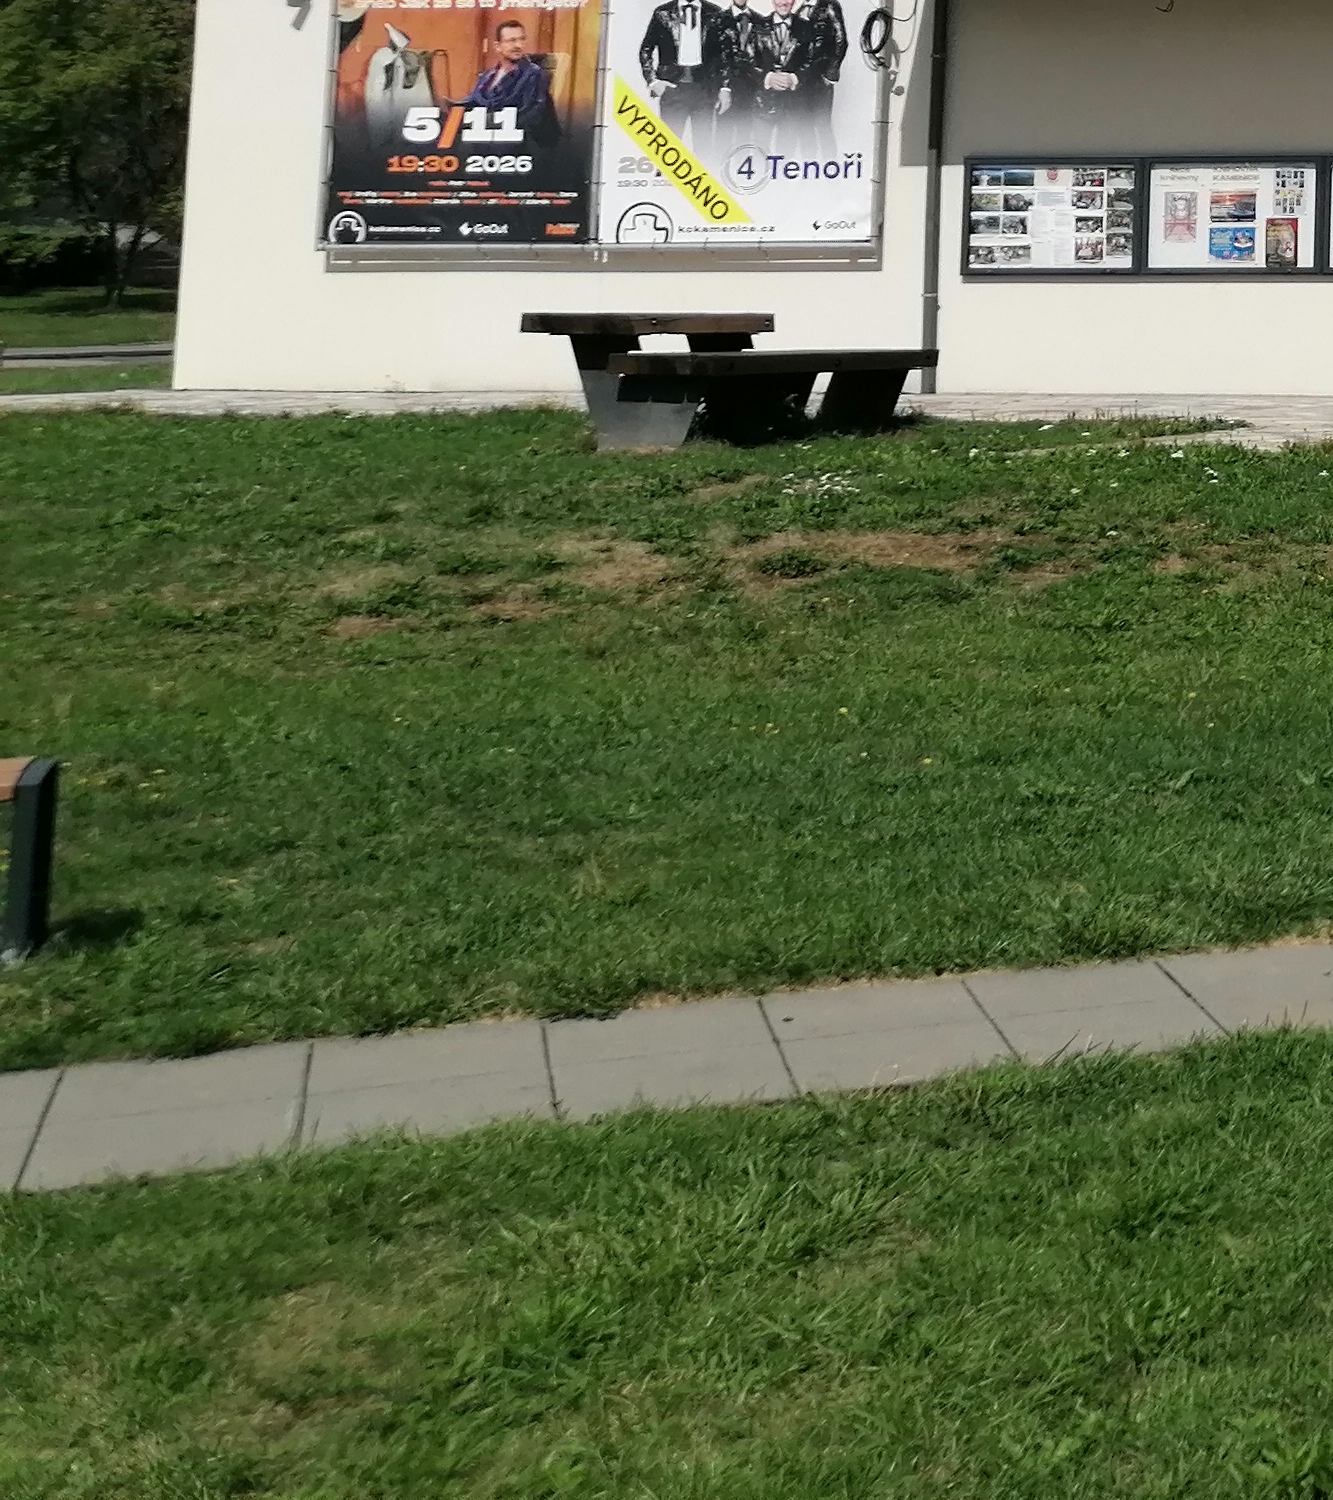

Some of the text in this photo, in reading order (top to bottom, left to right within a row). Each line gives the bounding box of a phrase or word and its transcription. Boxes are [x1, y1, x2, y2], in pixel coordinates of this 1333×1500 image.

[401, 105, 525, 150] 5/11
[386, 154, 534, 174] 19:30 2026
[616, 94, 730, 221] VYPRODÁNO
[737, 152, 864, 180] 4 Tenoři
